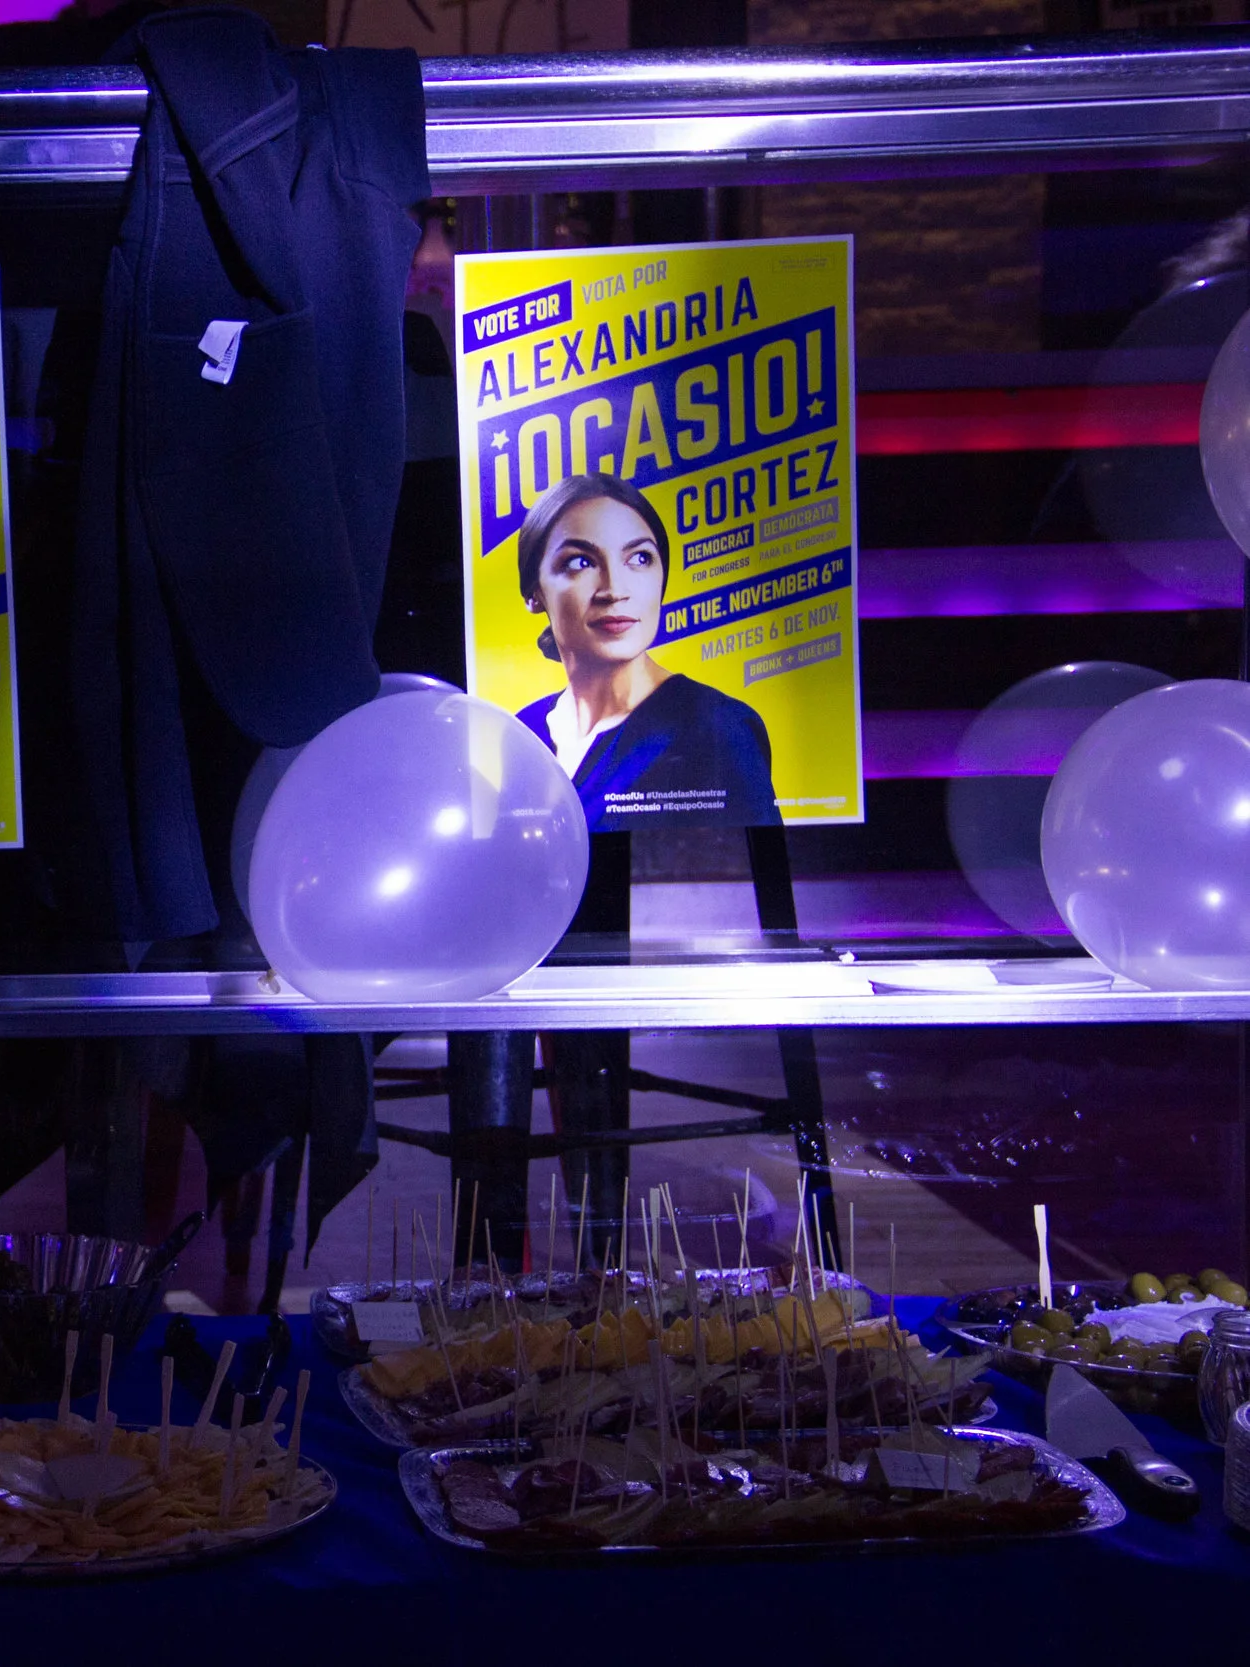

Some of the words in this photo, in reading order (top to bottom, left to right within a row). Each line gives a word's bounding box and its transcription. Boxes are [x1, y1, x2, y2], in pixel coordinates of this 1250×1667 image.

[581, 273, 626, 305] VOTA
[633, 259, 668, 290] POR
[473, 306, 519, 341] VOTE
[525, 293, 561, 323] FOR
[477, 276, 759, 408] ALEXANDRIA
[676, 440, 840, 535] CORTEZ
[763, 502, 835, 537] DEMÓCRATA
[686, 528, 751, 563] DEMOCRAT
[692, 569, 707, 583] FOR
[709, 556, 751, 577] CONGRESS
[665, 607, 688, 633] ON
[691, 597, 727, 625] TUE.
[729, 570, 818, 613] NOVEMBER
[821, 561, 844, 585] 6TH
[701, 626, 765, 662] MARTES
[769, 622, 779, 641] 6
[784, 613, 804, 637] DE
[808, 602, 842, 629] NOV.
[750, 656, 783, 677] BRONX
[798, 639, 837, 662] QUEENS
[604, 791, 645, 802] #OneofUs
[605, 802, 662, 814] #TeamOcasio
